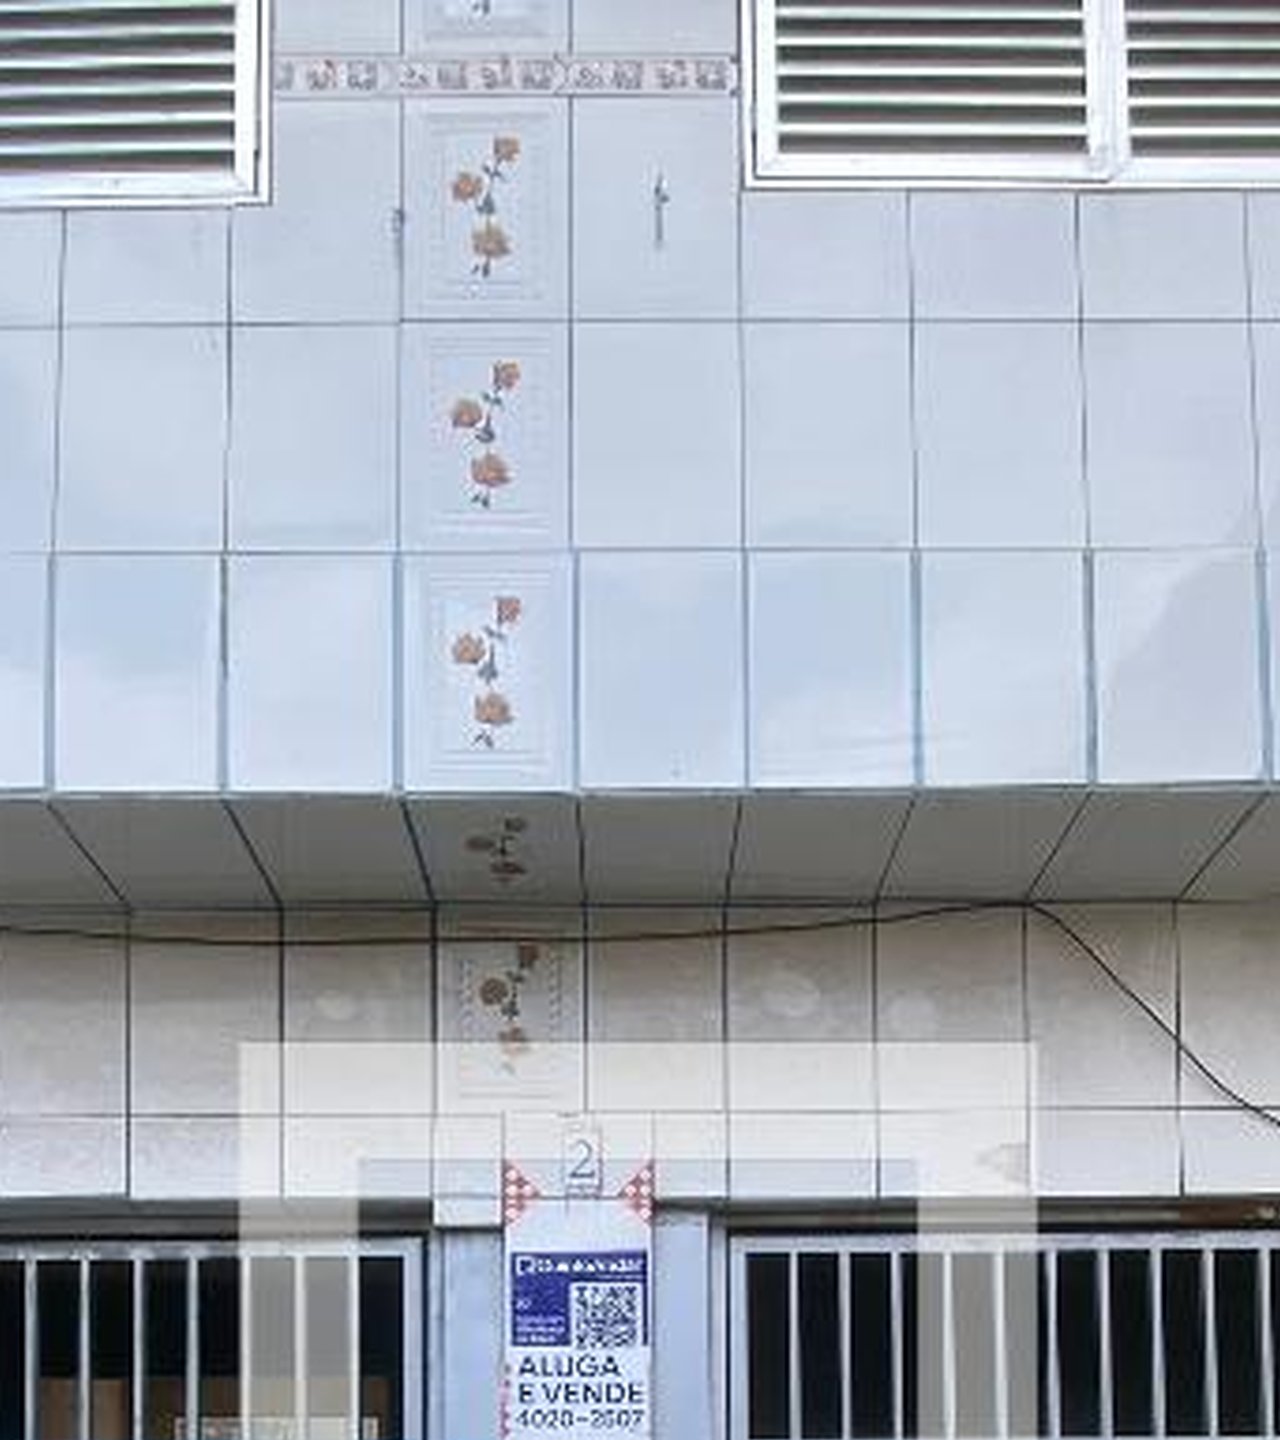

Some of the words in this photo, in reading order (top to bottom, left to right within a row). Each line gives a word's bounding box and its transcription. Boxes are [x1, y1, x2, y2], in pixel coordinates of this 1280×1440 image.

[569, 1139, 595, 1178] 2
[519, 1355, 621, 1377] ALUGA
[519, 1383, 534, 1403] E
[541, 1383, 644, 1403] VENDE
